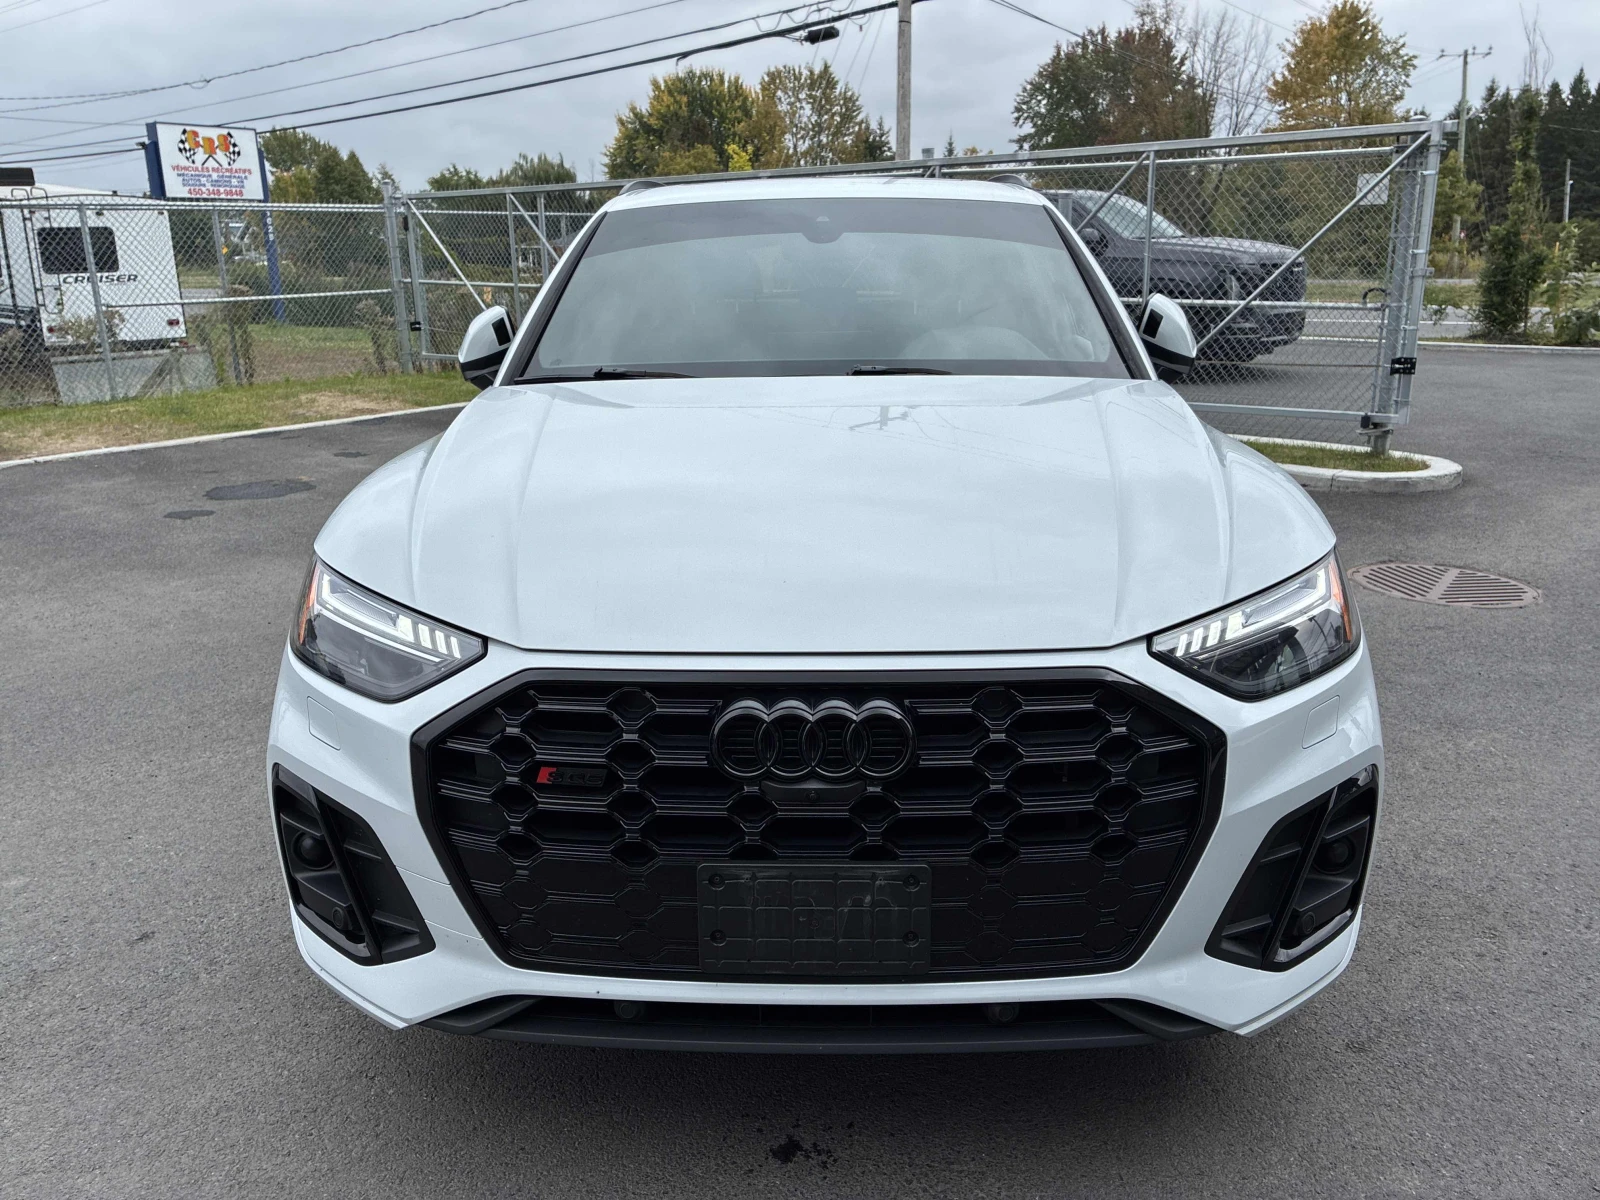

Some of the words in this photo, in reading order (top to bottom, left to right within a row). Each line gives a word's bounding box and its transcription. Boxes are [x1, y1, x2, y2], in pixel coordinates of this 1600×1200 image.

[186, 129, 231, 155] CRS
[171, 164, 210, 173] VÉHICULES
[211, 165, 252, 175] RÉCRÉATIFS
